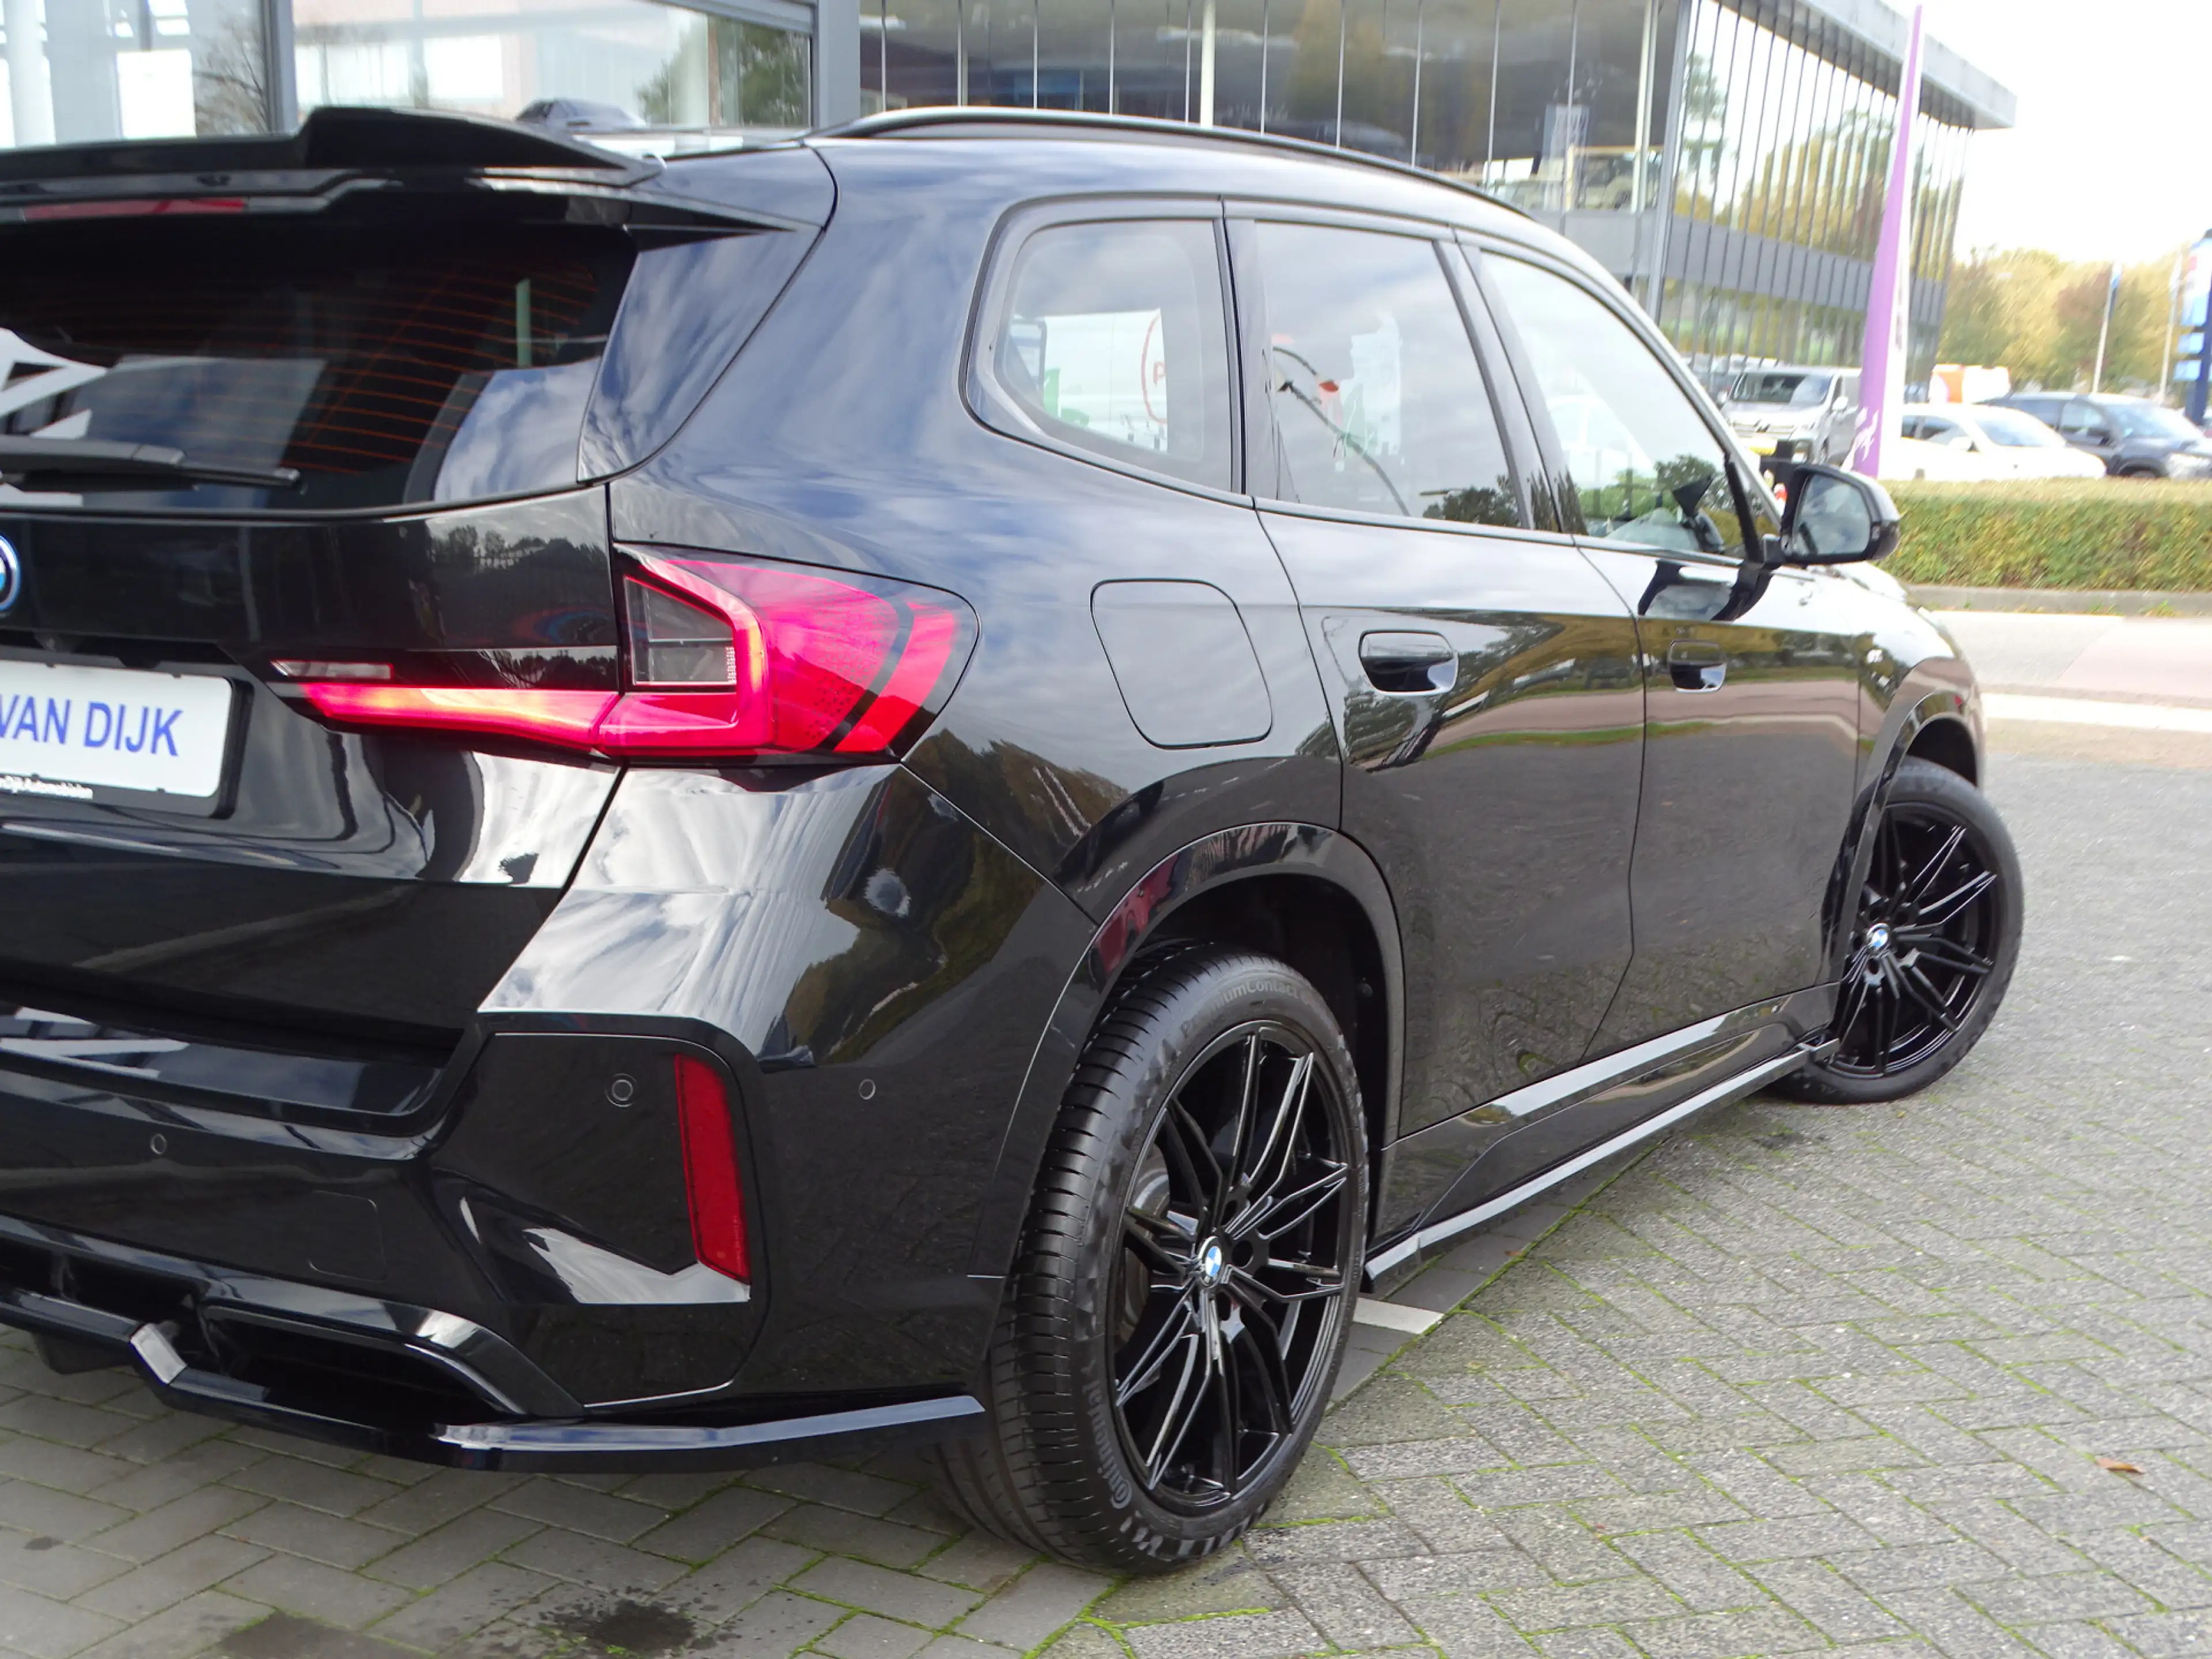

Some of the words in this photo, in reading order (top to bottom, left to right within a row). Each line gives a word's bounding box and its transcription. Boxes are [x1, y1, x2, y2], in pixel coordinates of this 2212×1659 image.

[0, 693, 71, 744] VAN
[84, 701, 183, 756] DIJK
[1082, 1381, 1132, 1509] Continental
